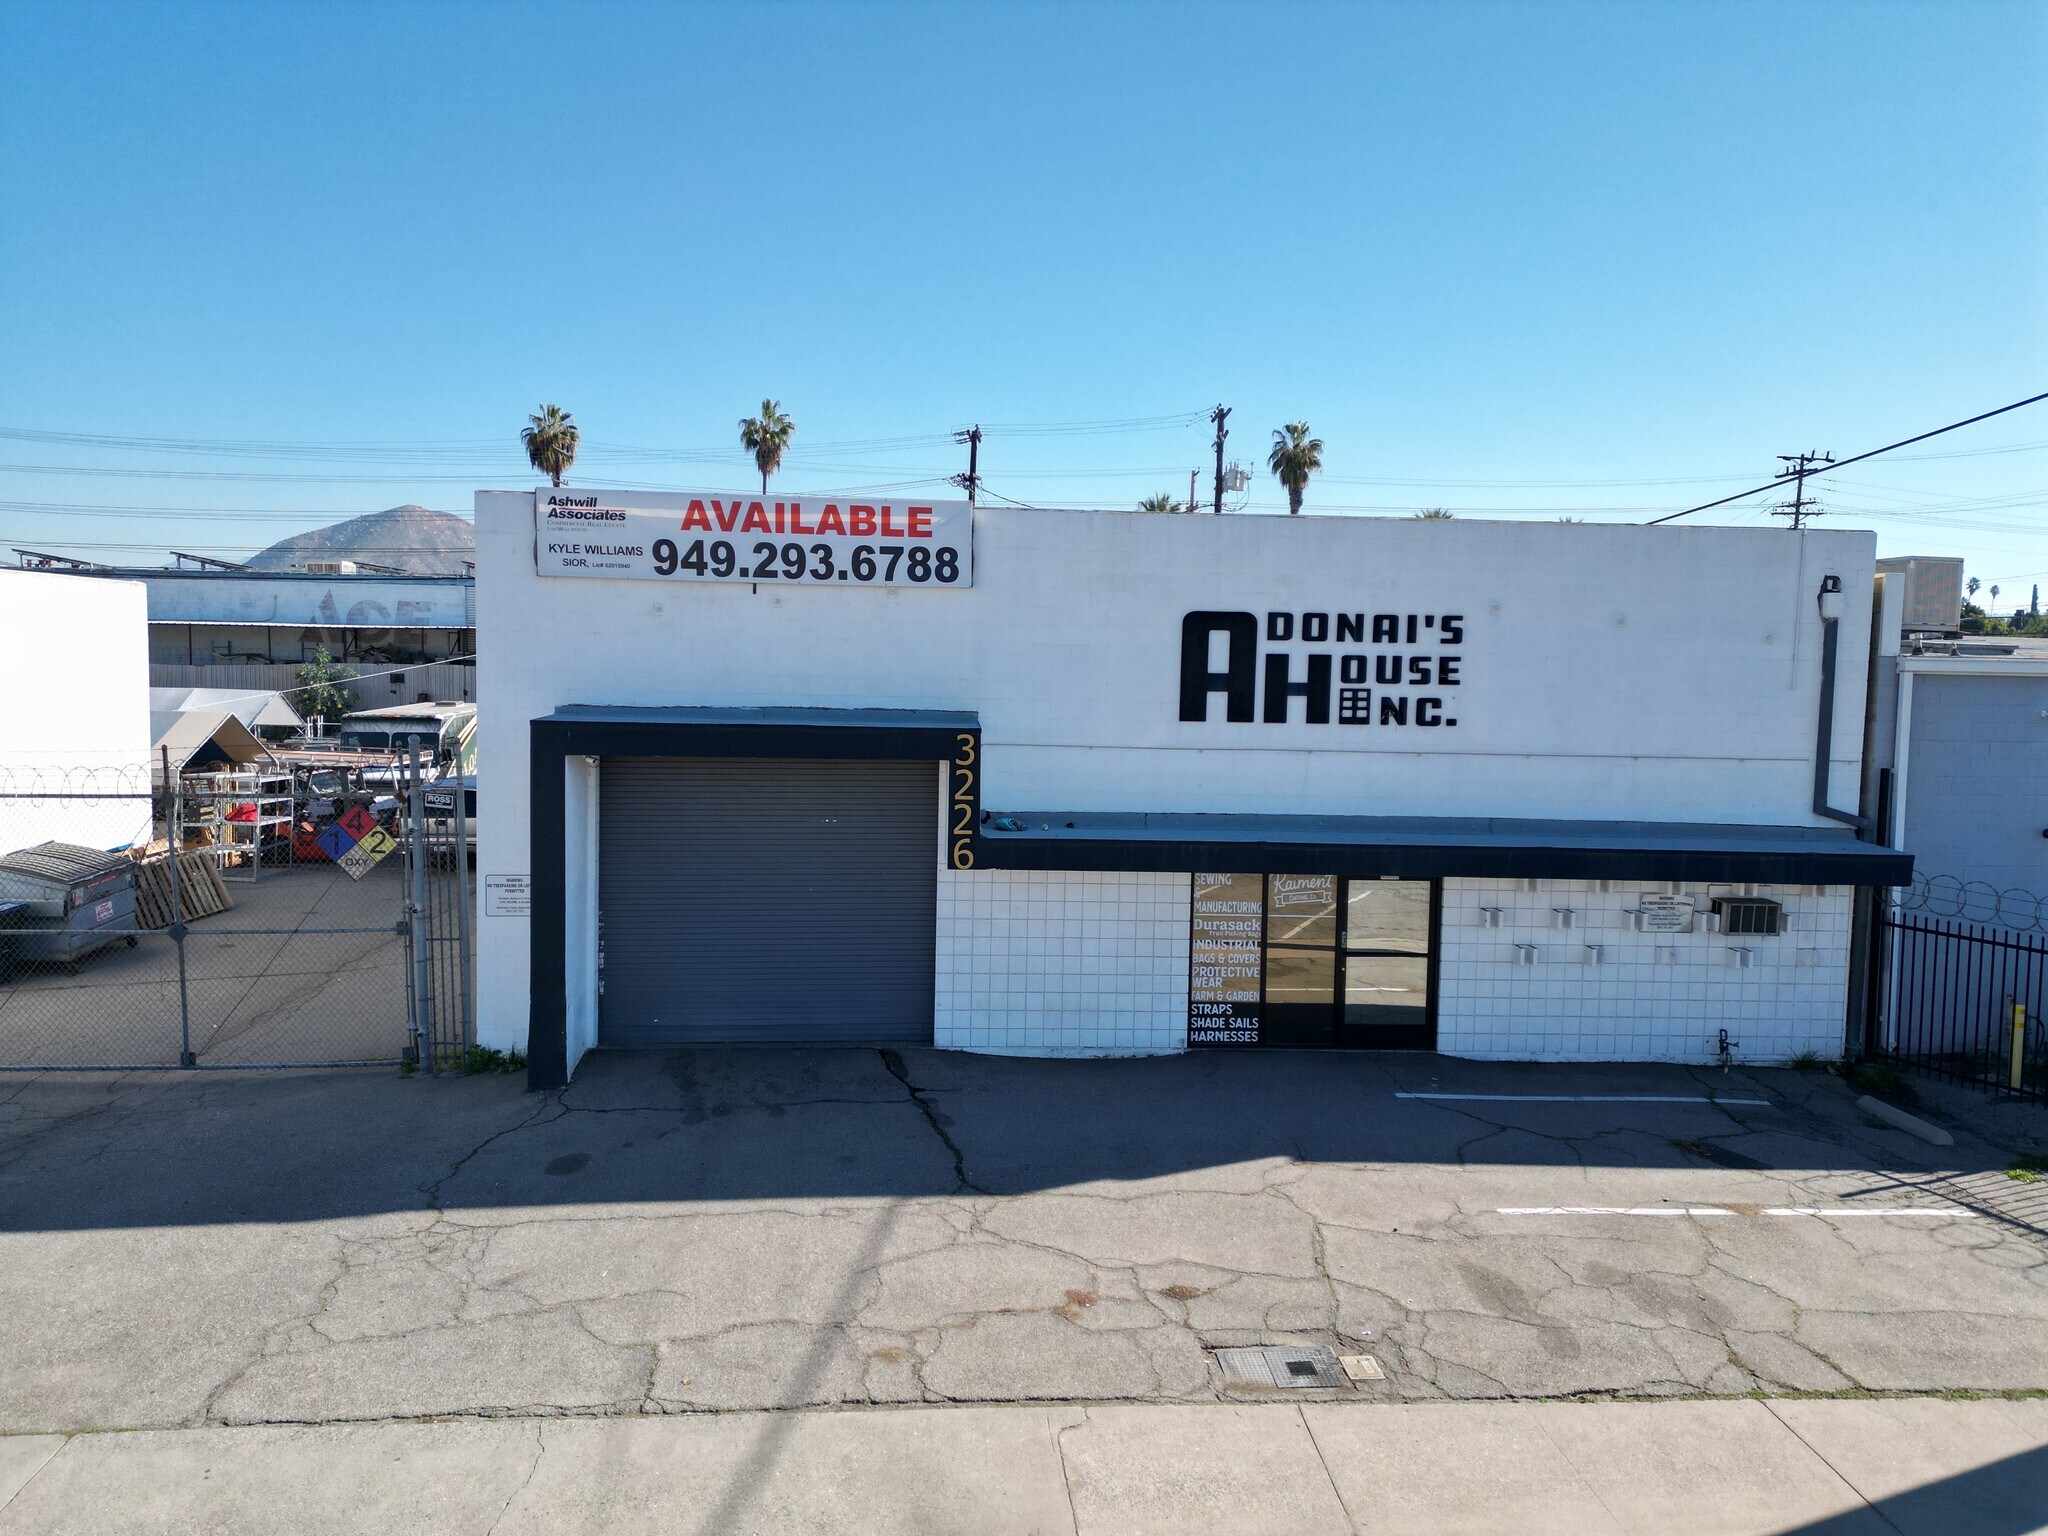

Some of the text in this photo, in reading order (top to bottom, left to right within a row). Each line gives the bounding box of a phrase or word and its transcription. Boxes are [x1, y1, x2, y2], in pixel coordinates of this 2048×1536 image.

[548, 496, 597, 507] Ashwill
[548, 508, 626, 521] Associates
[681, 500, 933, 538] AVAILABLE
[549, 543, 643, 556] KYLE WILLIAMS
[562, 558, 589, 568] SIOR,
[652, 539, 959, 583] 949.293.6788
[427, 795, 451, 804] ROSS
[953, 734, 975, 870] 3226
[346, 810, 365, 834] 4
[329, 829, 386, 854] 1 2
[345, 857, 369, 867] OXY
[1194, 873, 1232, 885] SEWING
[1194, 901, 1262, 913] MANUFACTURING
[1194, 918, 1261, 931] Durasack
[1193, 939, 1261, 950] INDUSTRIAL
[1193, 954, 1260, 964] BAGS & COVERS
[1192, 966, 1260, 977] PROTECTIVE
[1192, 977, 1222, 987] WEAR
[1192, 991, 1260, 1001] FARM & GARDEN
[1191, 1004, 1233, 1014] STRAPS
[1191, 1017, 1259, 1028] SHADE SAILS
[1190, 1031, 1258, 1041] HARNESSES
